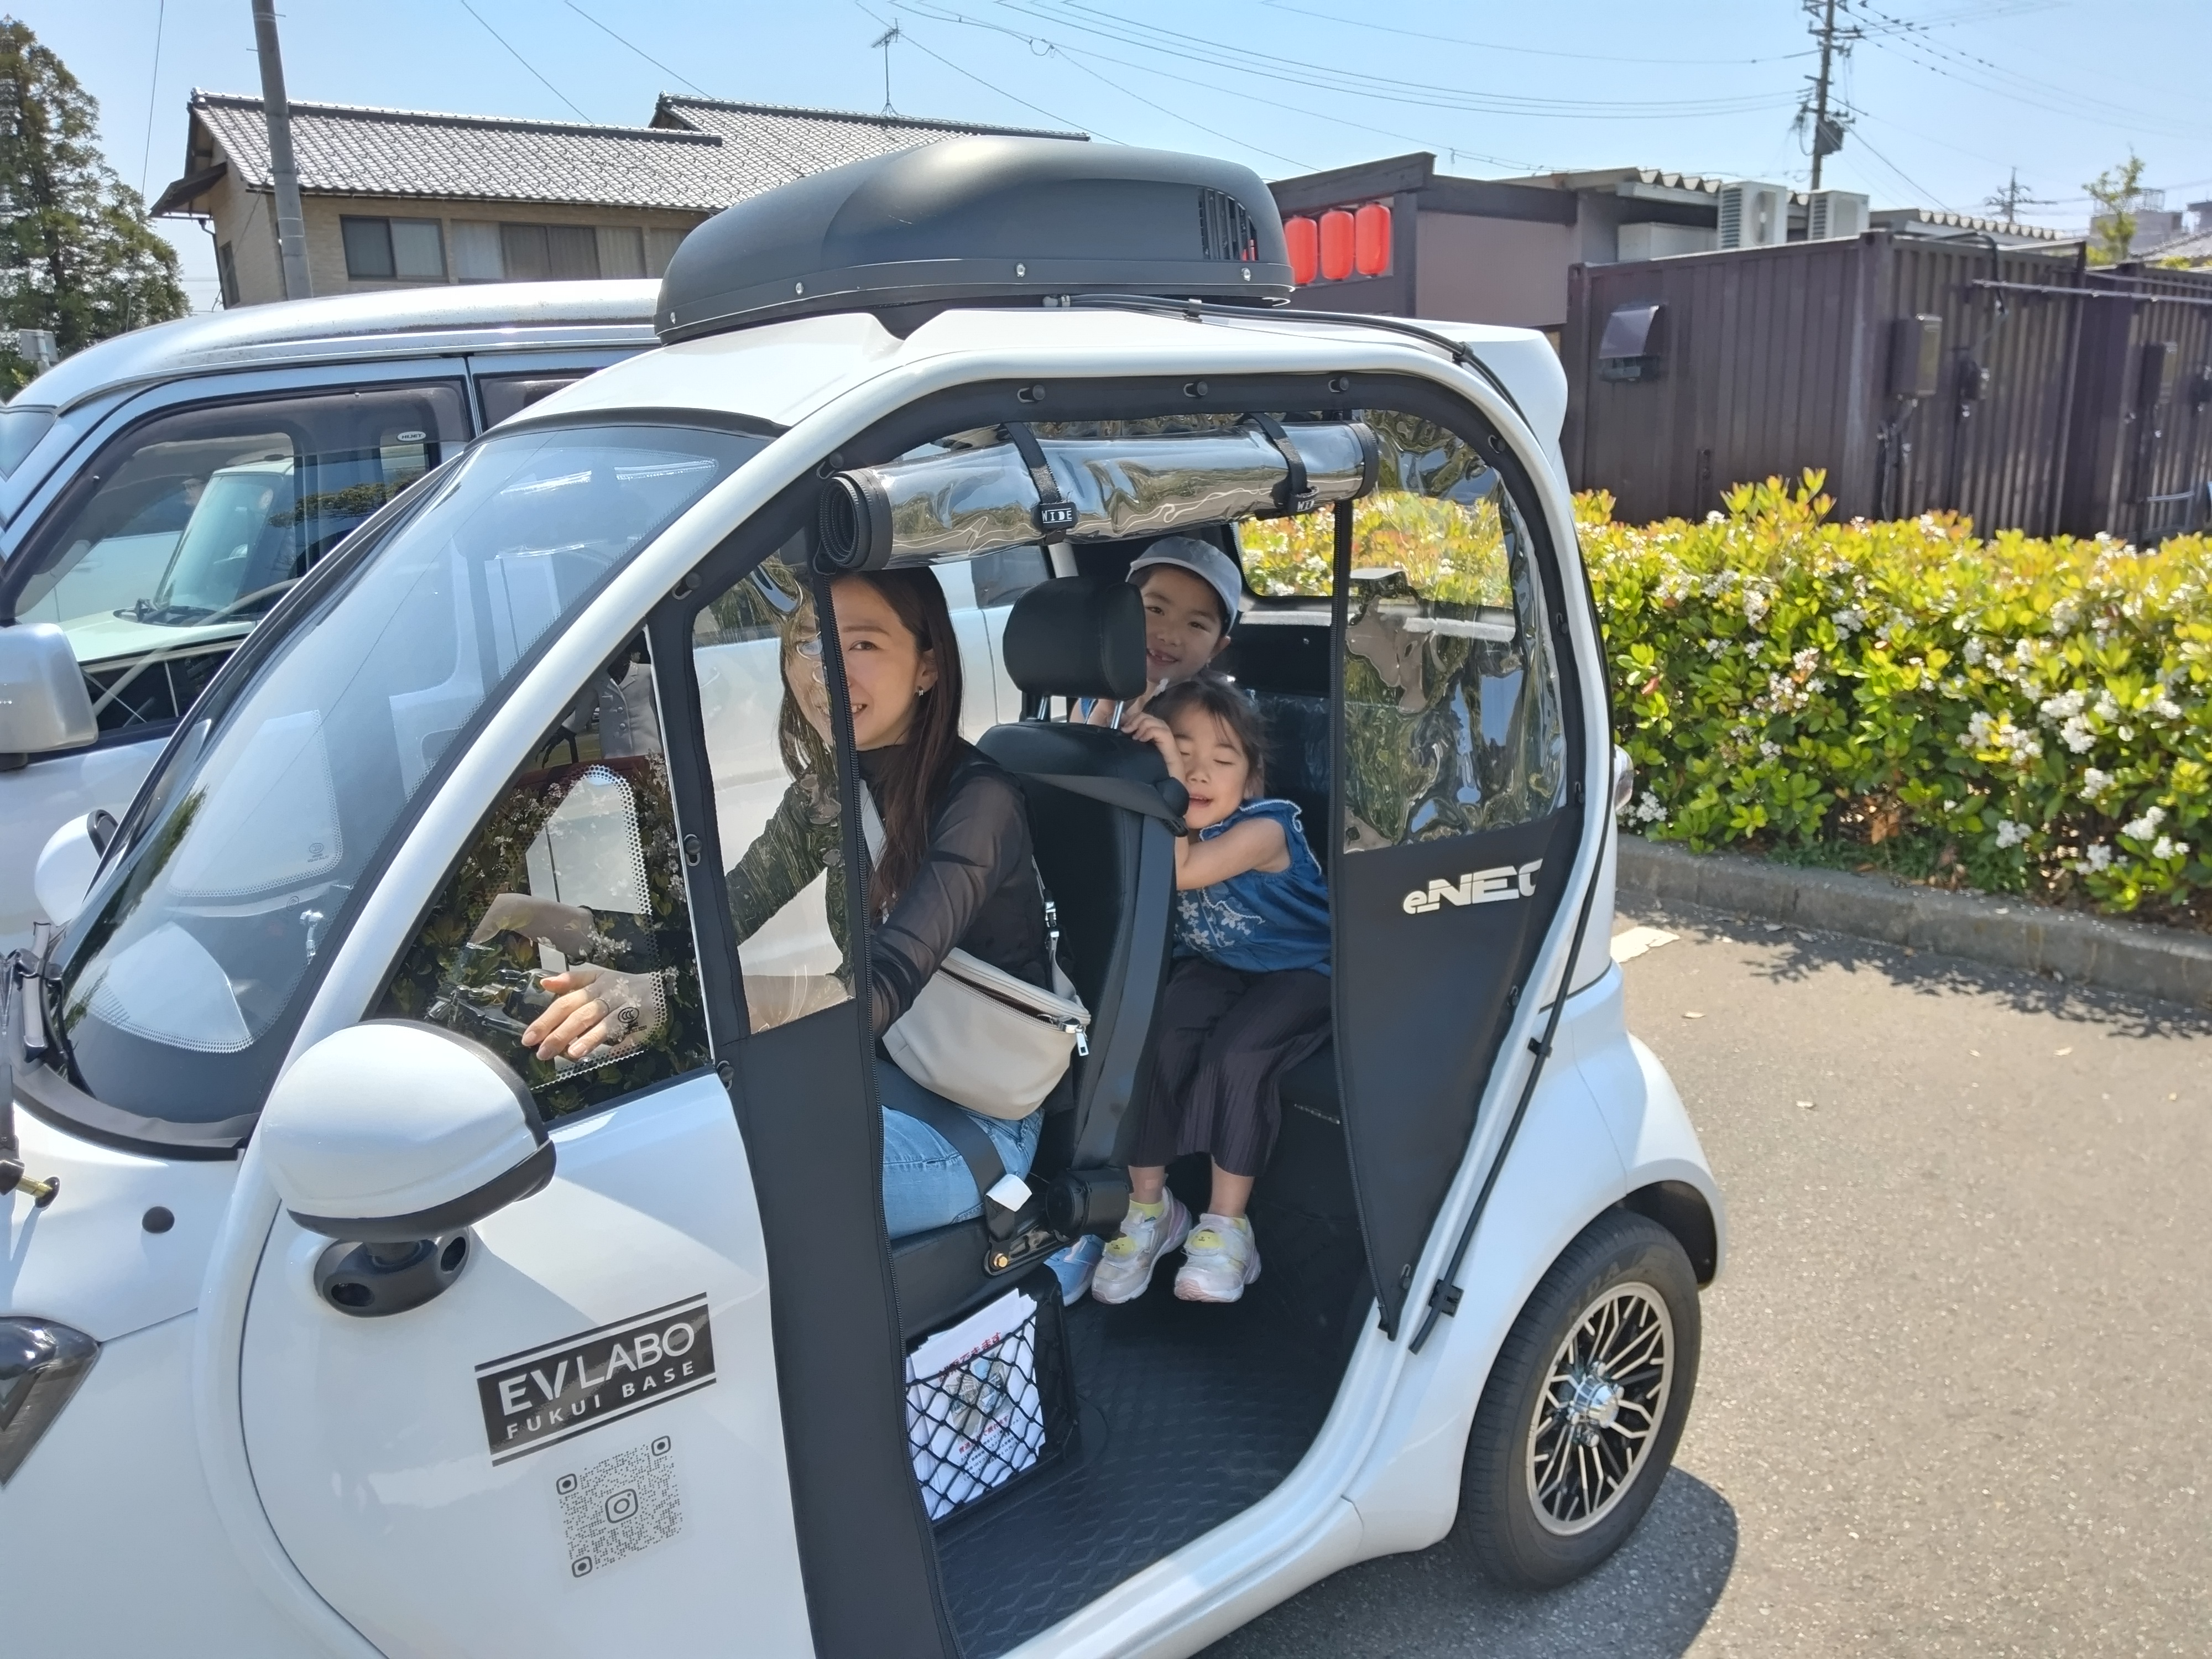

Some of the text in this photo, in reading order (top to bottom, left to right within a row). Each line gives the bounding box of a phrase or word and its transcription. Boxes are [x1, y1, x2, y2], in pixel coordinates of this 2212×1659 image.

[1041, 510, 1072, 522] WIDE
[498, 1322, 695, 1416] EV LABO
[506, 1360, 695, 1439] FUKUI BASE
